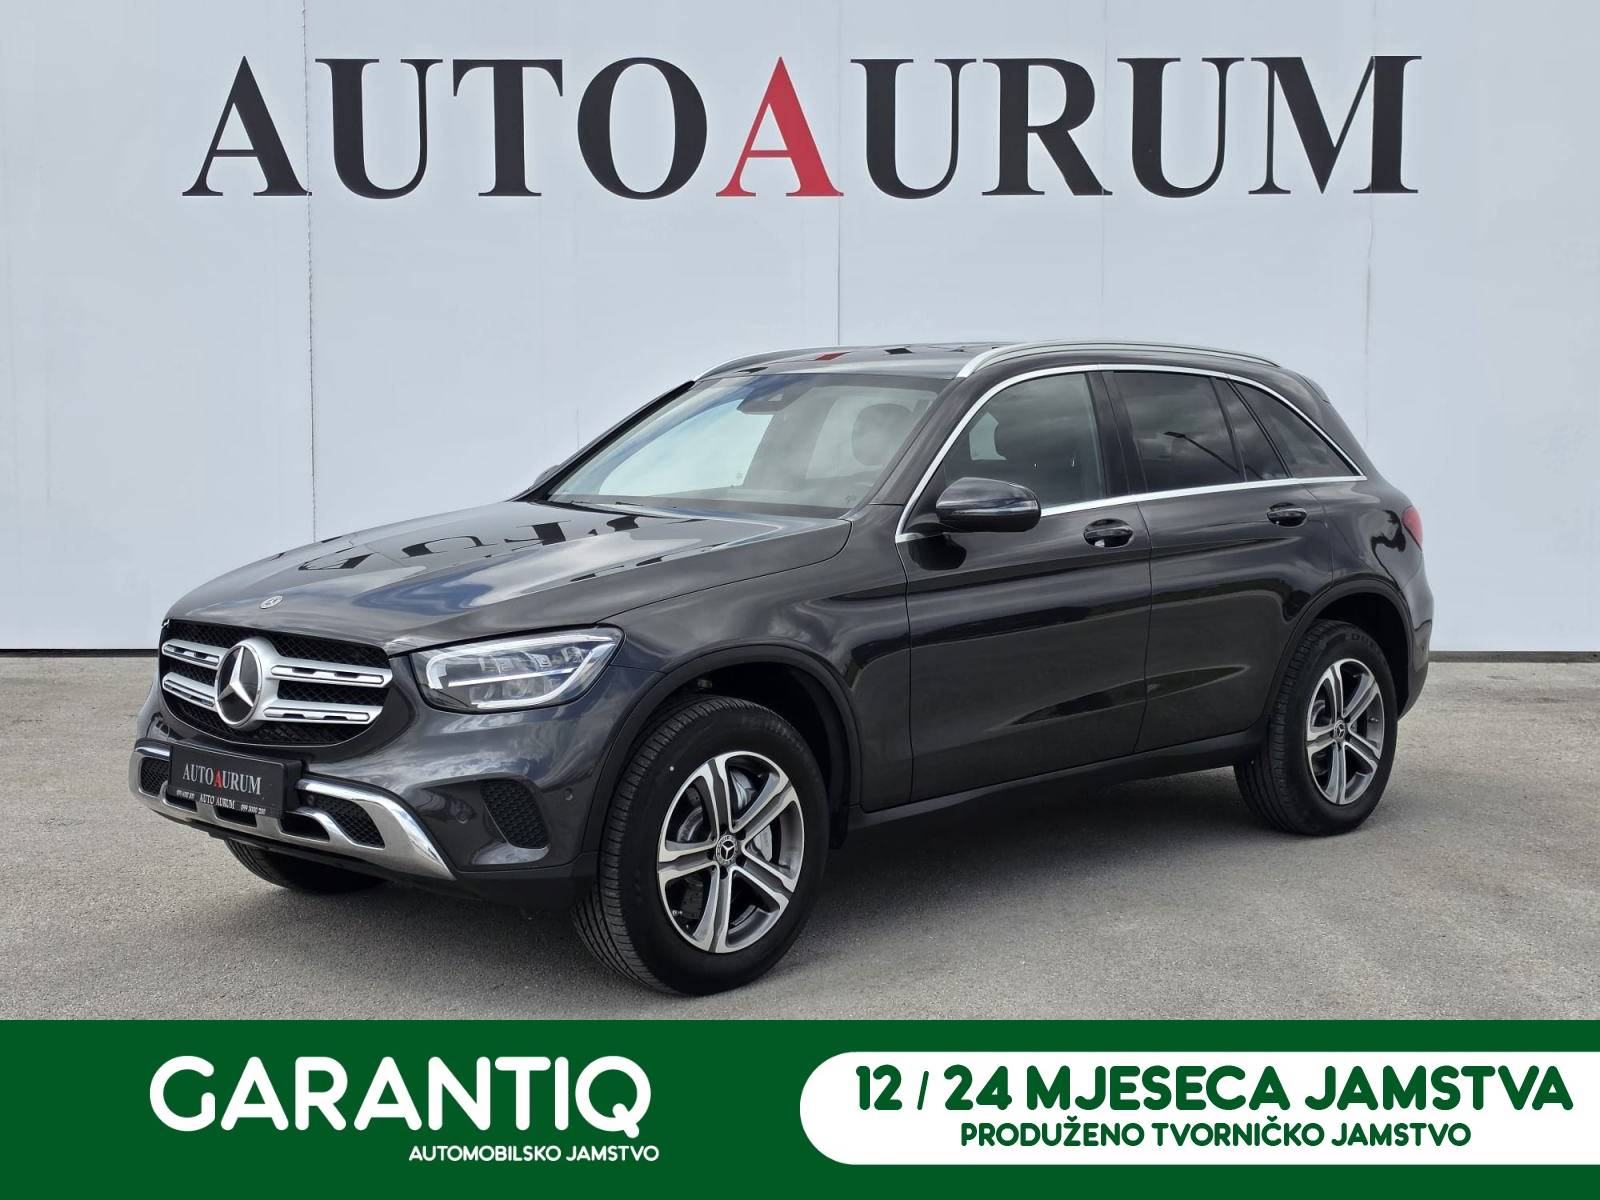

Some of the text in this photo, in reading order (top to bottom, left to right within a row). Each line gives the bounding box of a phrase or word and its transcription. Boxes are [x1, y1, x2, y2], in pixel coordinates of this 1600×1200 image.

[183, 55, 1422, 200] AUTOAURUM
[182, 763, 262, 795] AUTOAURUM
[199, 793, 215, 805] AUTO
[215, 796, 236, 809] AURUM
